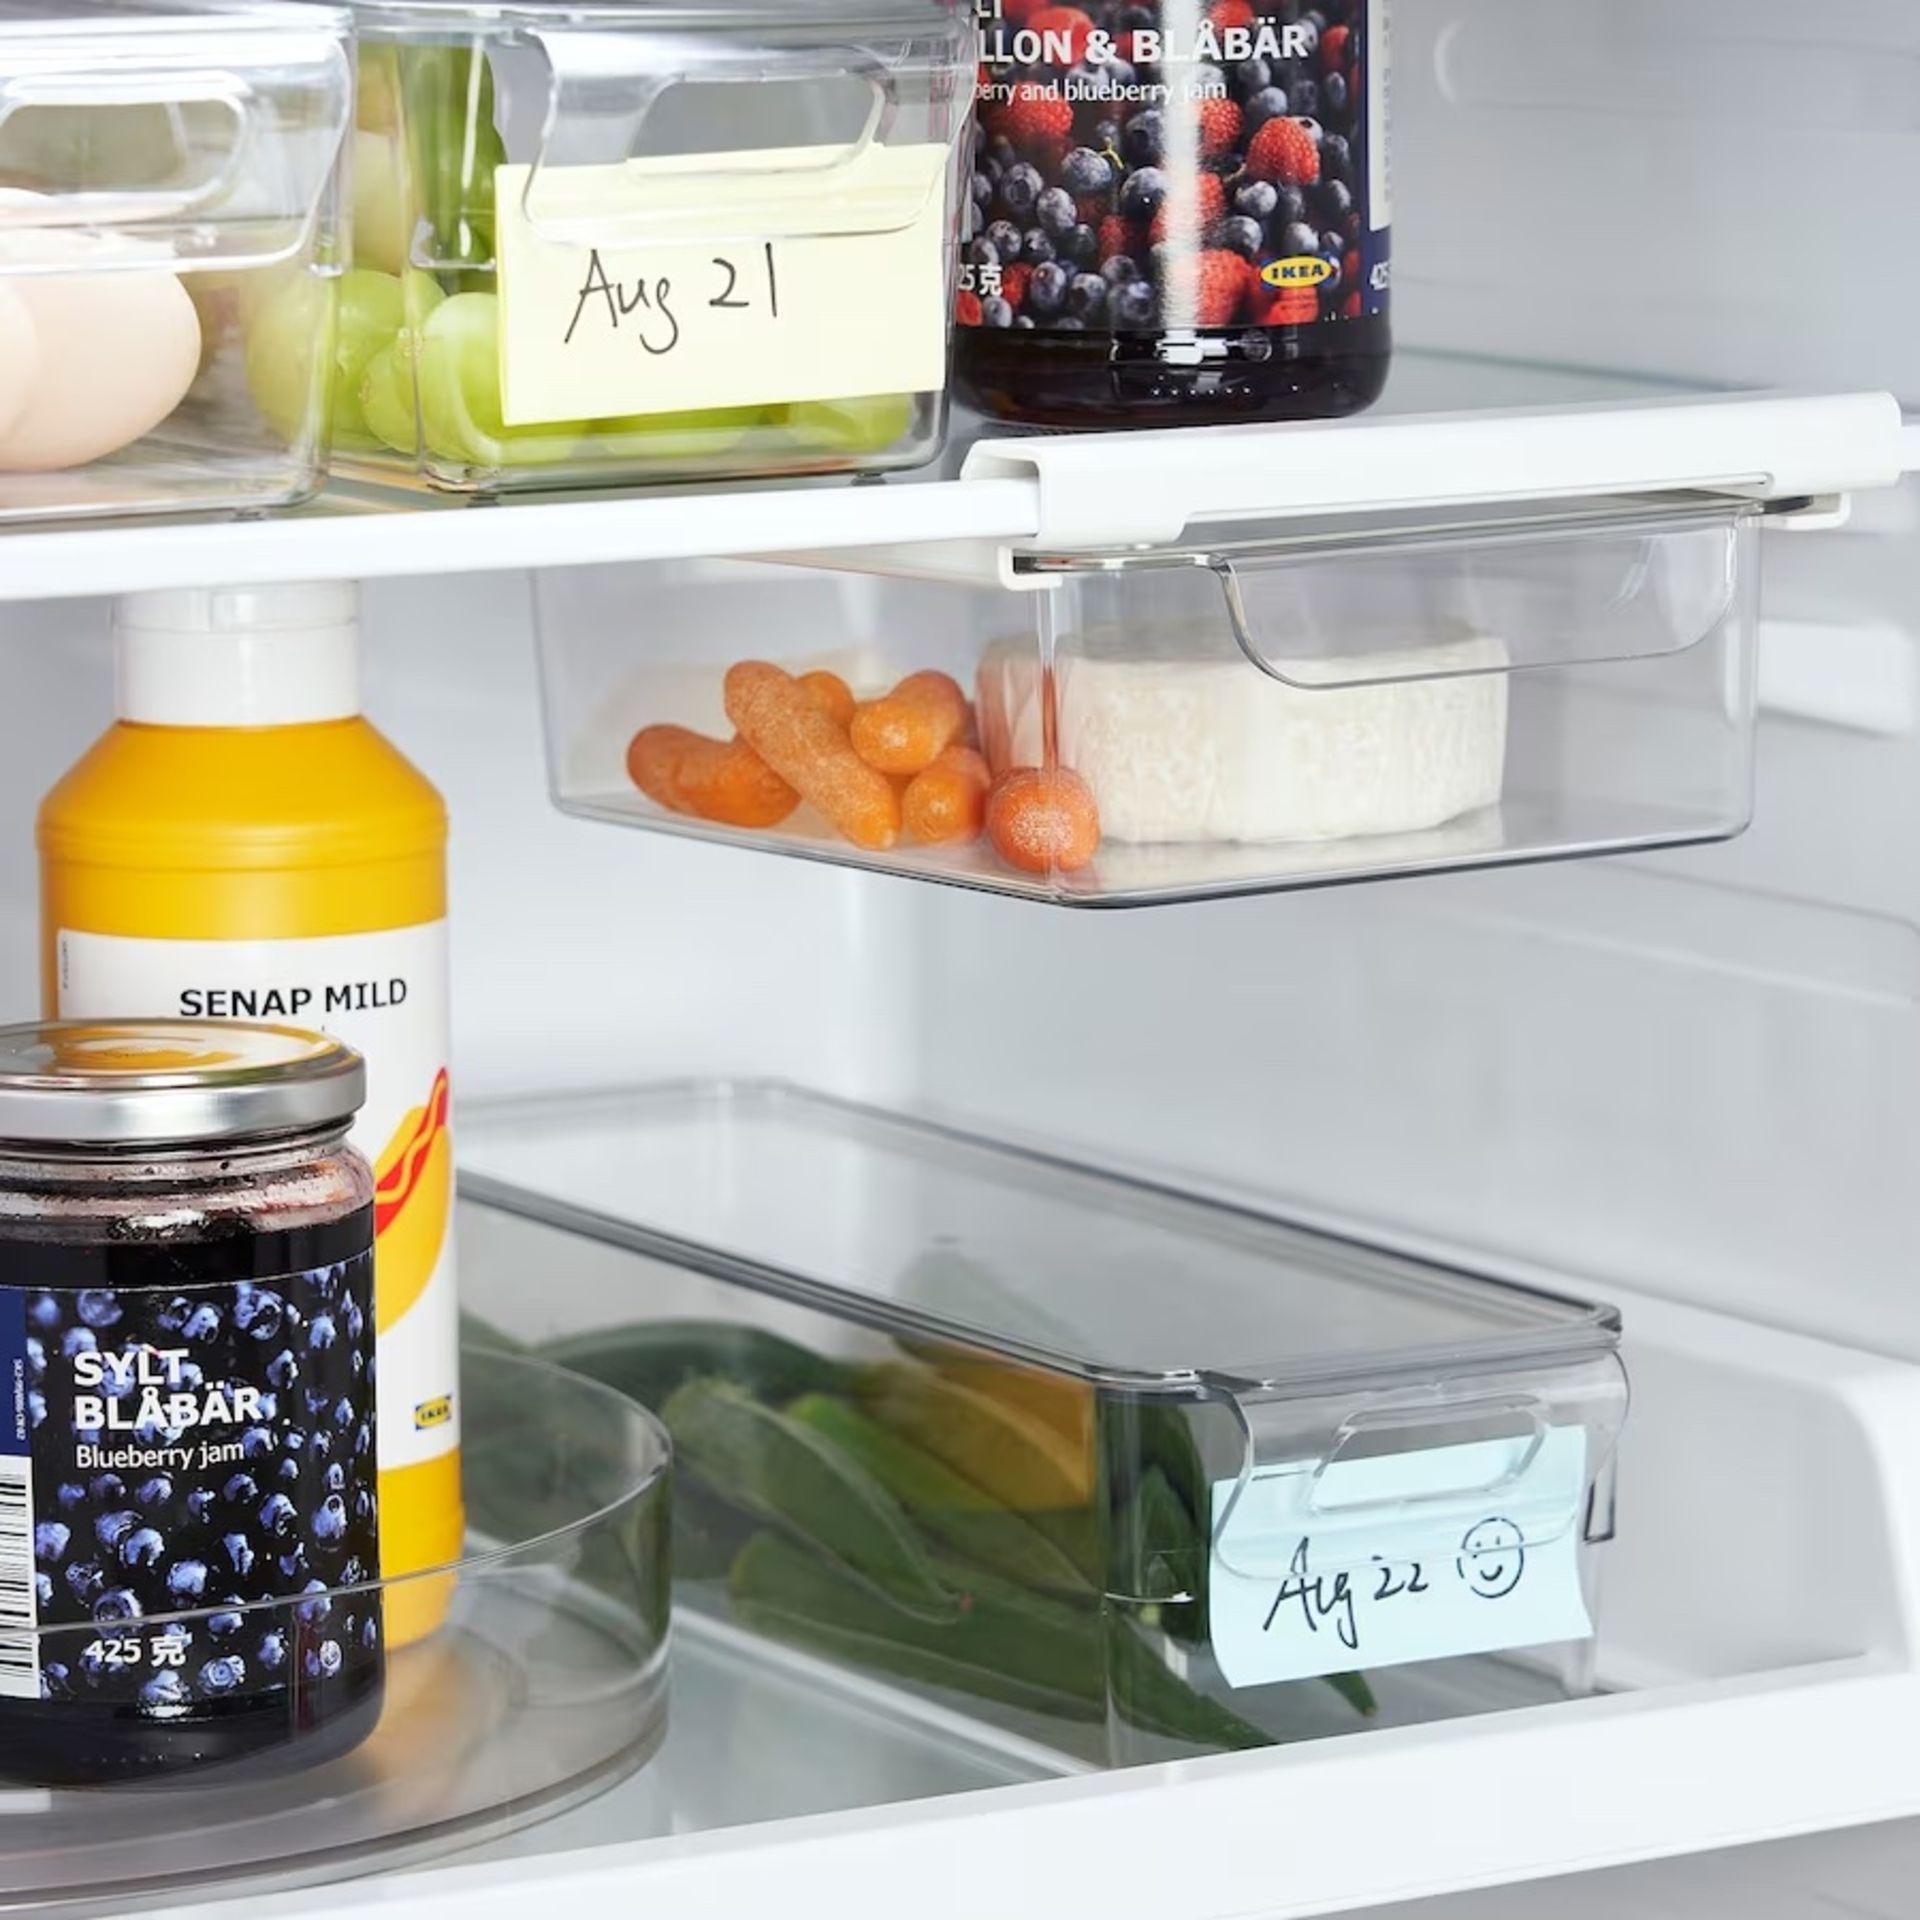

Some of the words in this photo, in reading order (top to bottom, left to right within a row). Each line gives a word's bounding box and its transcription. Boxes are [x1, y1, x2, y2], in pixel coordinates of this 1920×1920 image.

[1085, 29, 1118, 65] &
[1132, 17, 1309, 63] BLÅBÄR
[1020, 79, 1059, 102] and
[1064, 78, 1172, 106] blueberry
[1184, 81, 1227, 106] jam
[564, 248, 678, 355] Aug
[708, 242, 777, 318] 21
[180, 989, 312, 1017] SENAP
[325, 978, 407, 1013] MILD
[73, 1348, 189, 1386] SYLT
[74, 1380, 264, 1431] BLÅBÄR
[75, 1444, 194, 1470] Blueberry
[198, 1441, 245, 1470] jam
[1262, 1536, 1358, 1650] Aug
[85, 1637, 142, 1666] 425
